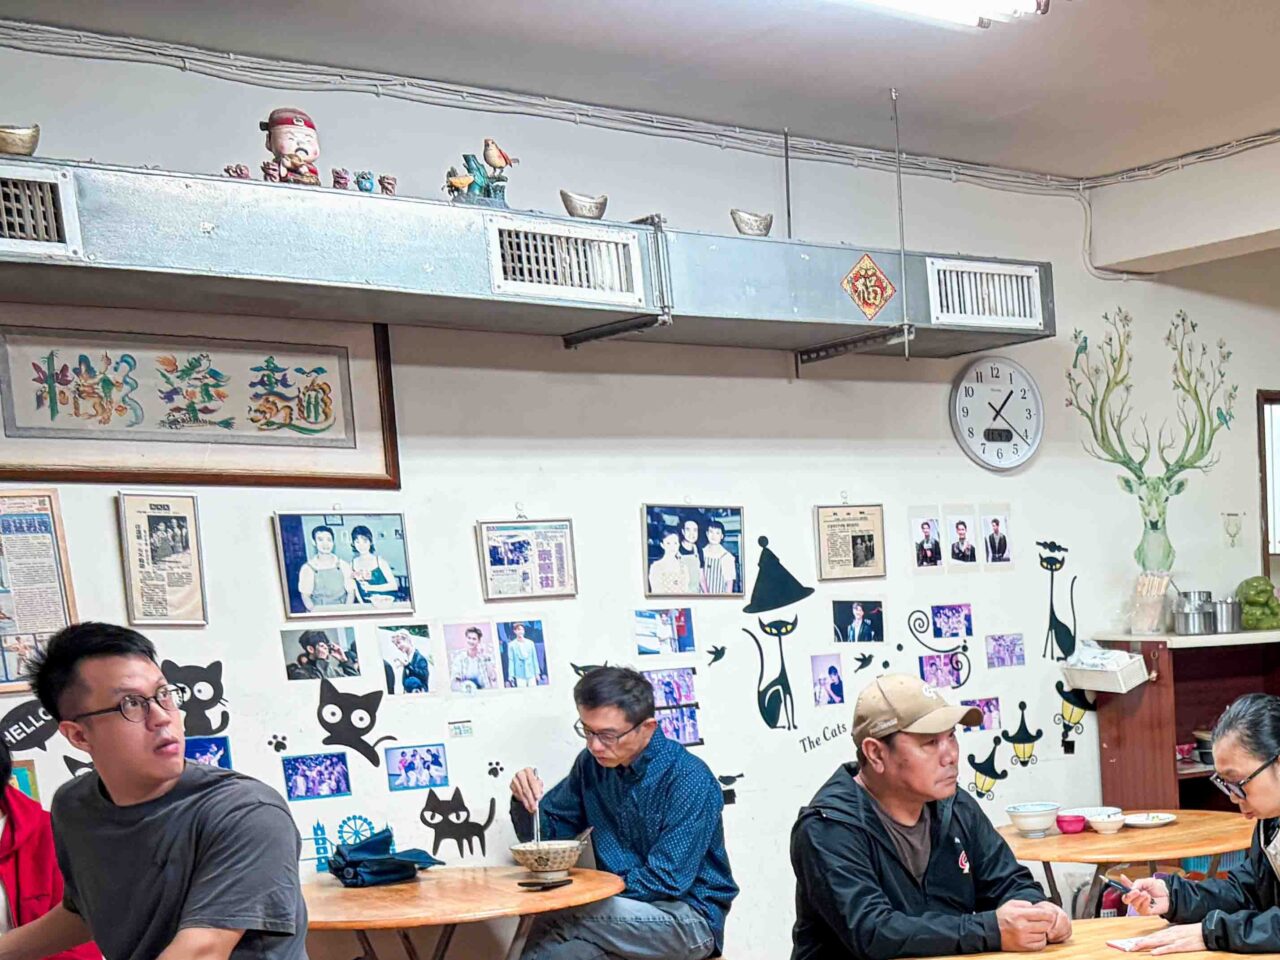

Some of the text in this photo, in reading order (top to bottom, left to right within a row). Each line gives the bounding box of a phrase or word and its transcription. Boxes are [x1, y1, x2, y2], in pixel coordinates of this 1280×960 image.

[854, 275, 881, 306] 福
[799, 723, 847, 753] The Cats
